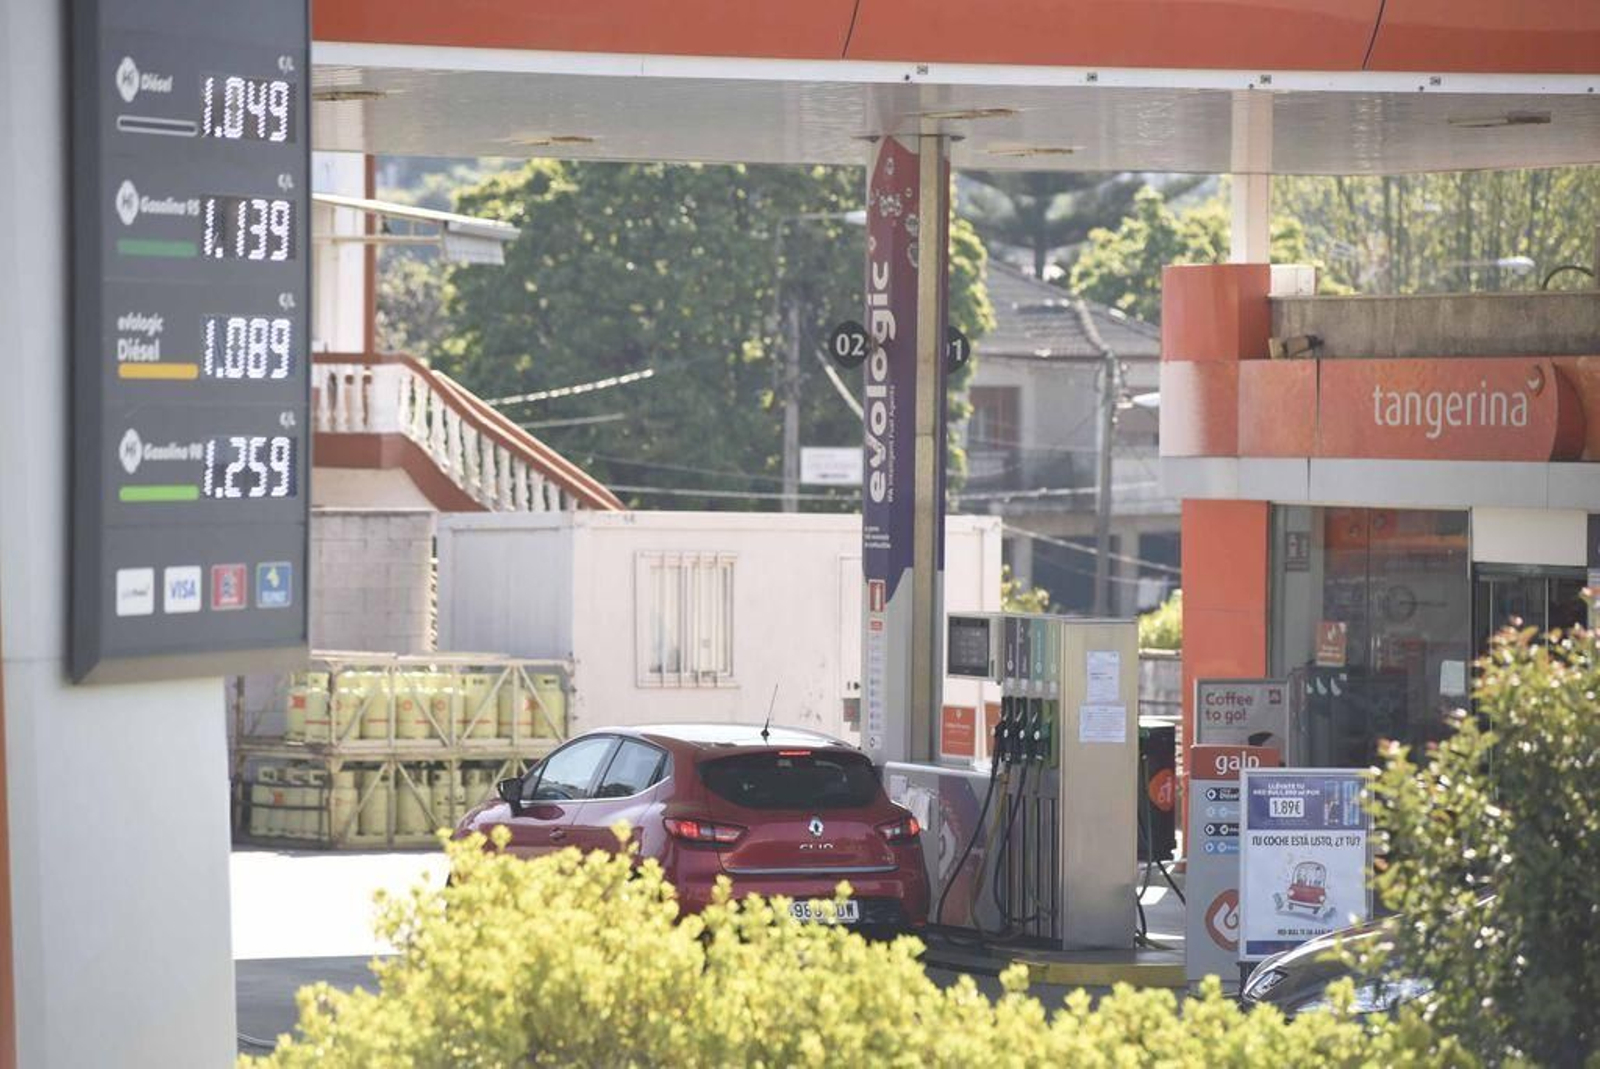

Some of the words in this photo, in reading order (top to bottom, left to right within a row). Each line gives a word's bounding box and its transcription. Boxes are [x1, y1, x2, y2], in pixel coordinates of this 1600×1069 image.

[202, 76, 290, 141] 1.049
[203, 198, 290, 260] 1.139
[204, 317, 291, 378] 1.089
[836, 334, 864, 356] 02
[866, 261, 895, 503] evologic
[1373, 380, 1528, 439] tangerina
[204, 437, 291, 498] 1.259
[170, 579, 196, 600] VISA
[1205, 691, 1253, 707] Coffee
[1205, 709, 1221, 721] to
[1225, 708, 1247, 725] go!
[1273, 800, 1301, 815] 1.89€
[1263, 837, 1289, 846] COCHE
